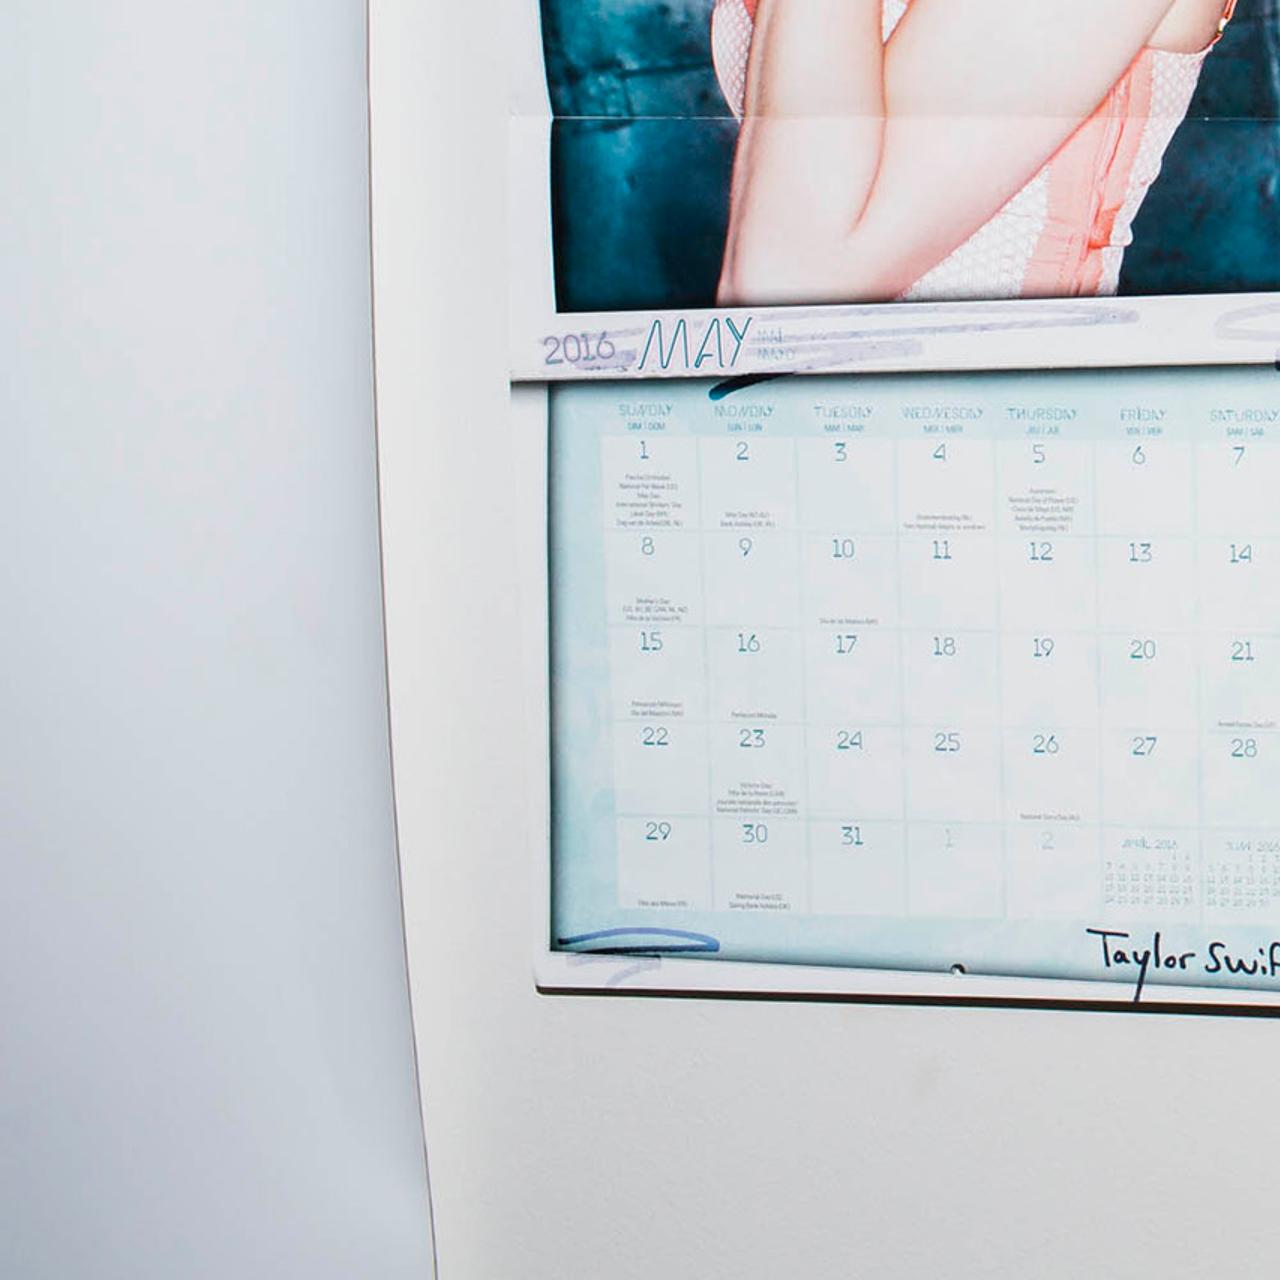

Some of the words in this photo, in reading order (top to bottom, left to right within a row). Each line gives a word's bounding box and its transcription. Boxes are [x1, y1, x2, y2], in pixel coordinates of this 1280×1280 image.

[543, 332, 616, 365] 2016
[638, 316, 752, 370] MAY
[619, 403, 672, 418] SUNDAY
[714, 404, 775, 418] MONDAY
[814, 405, 873, 420] TUESDAY
[1006, 407, 1078, 421] THURSDAY
[1120, 407, 1166, 422] FRIDAY
[1210, 408, 1280, 423] SATURDAY
[640, 441, 649, 459] 1
[737, 442, 749, 460] 2
[835, 443, 846, 461] 3
[933, 444, 945, 460] 4
[1033, 445, 1045, 463] 5
[1133, 446, 1145, 464] 6
[1233, 447, 1244, 464] 7
[641, 537, 654, 555] 8
[740, 538, 752, 557] 9
[833, 539, 854, 557] 10
[933, 541, 951, 559] 11
[1030, 542, 1052, 560] 12
[1130, 543, 1151, 562] 13
[1231, 544, 1251, 563] 14
[641, 632, 662, 651] 15
[739, 634, 759, 652] 16
[837, 635, 856, 653] 17
[934, 637, 955, 656] 18
[1034, 639, 1053, 657] 19
[1130, 642, 1155, 659] 20
[1232, 642, 1254, 661] 21
[643, 727, 668, 745] 22
[740, 729, 764, 747] 23
[837, 731, 861, 750] 24
[935, 733, 959, 751] 25
[1034, 736, 1059, 753] 26
[1133, 737, 1156, 755] 27
[1232, 739, 1257, 757] 28
[646, 823, 671, 840] 29
[743, 824, 767, 842] 30
[842, 827, 863, 845] 31
[945, 830, 954, 849] 1
[1042, 831, 1054, 849] 2
[1086, 927, 1196, 1002] Taylor
